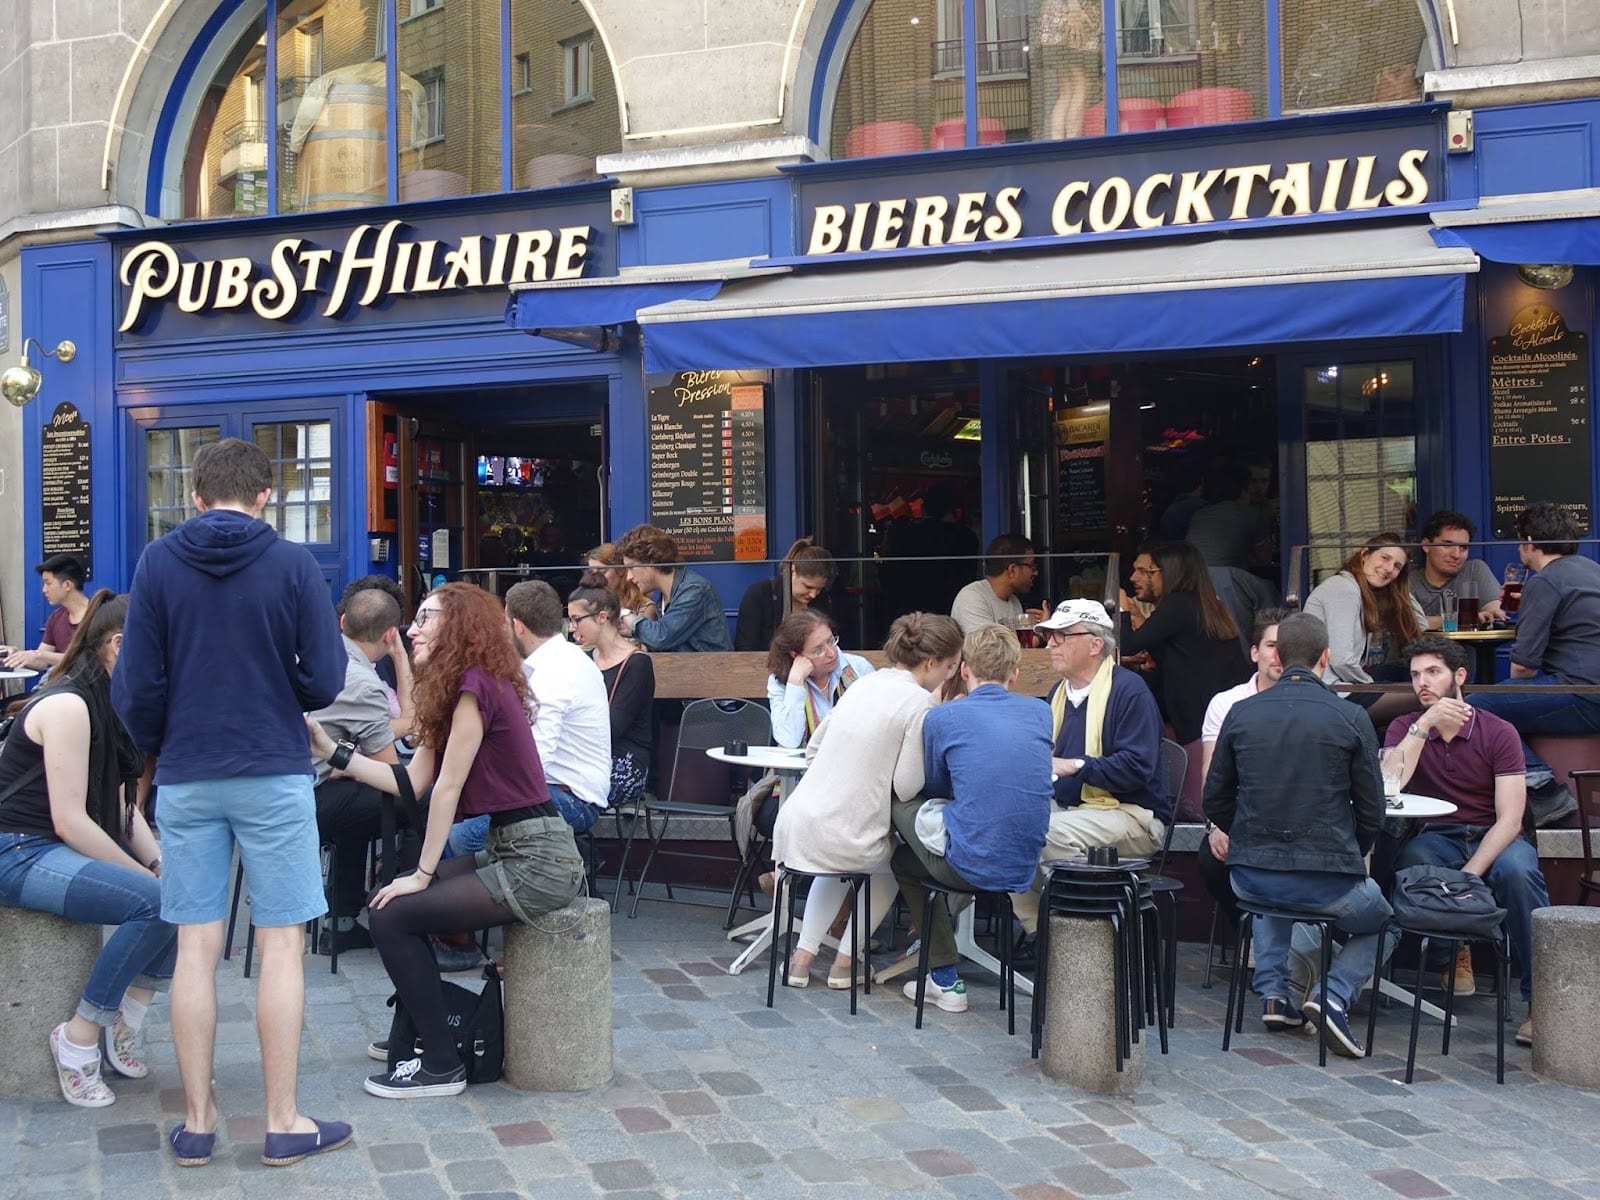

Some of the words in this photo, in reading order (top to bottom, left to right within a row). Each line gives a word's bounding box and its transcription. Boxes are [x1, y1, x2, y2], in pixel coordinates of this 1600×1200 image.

[805, 186, 1025, 256] BIERES
[1050, 149, 1430, 236] COCKTAILS
[323, 219, 591, 317] HILAIRE
[1492, 353, 1531, 363] Cocktails
[1492, 377, 1536, 387] Mètres
[674, 383, 732, 407] Pression
[651, 433, 674, 441] Carlsberg
[1492, 434, 1526, 445] Entre
[1531, 433, 1564, 443] Potes
[651, 443, 674, 451] Carlsberg
[680, 517, 692, 525] LES
[447, 1014, 461, 1027] US
